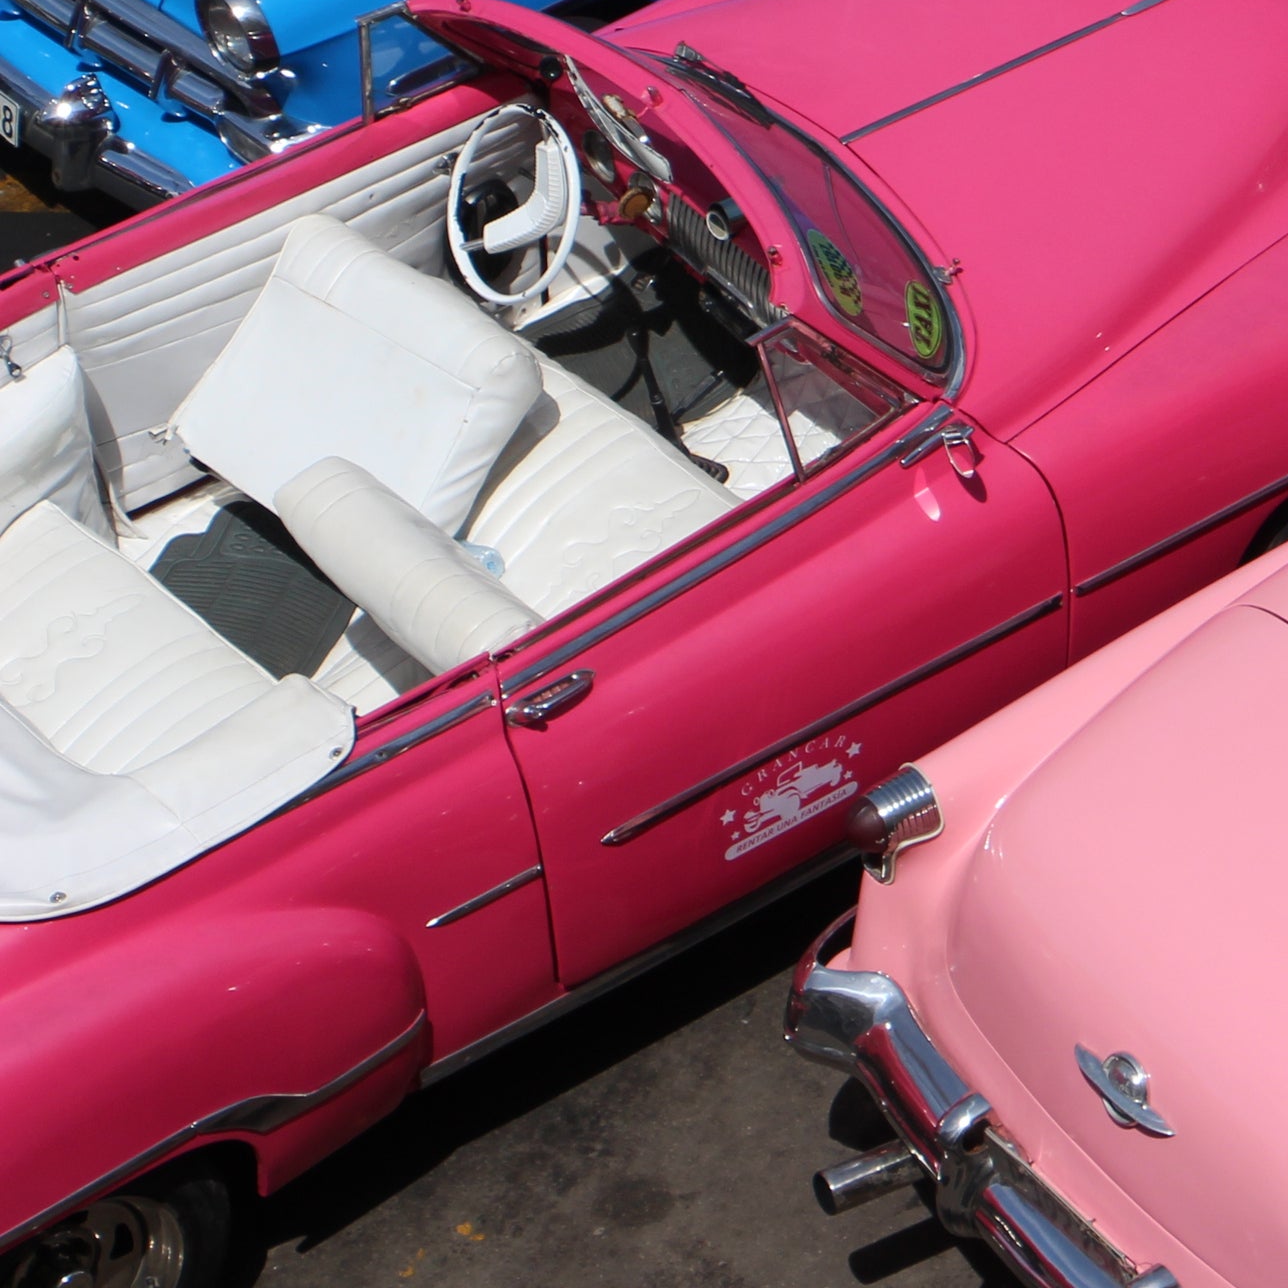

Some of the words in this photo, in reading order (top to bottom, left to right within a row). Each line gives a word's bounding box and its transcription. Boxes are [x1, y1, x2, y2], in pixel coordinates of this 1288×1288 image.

[2, 104, 14, 139] 8
[911, 284, 932, 349] TAXI
[741, 735, 847, 796] GRANCAR
[736, 828, 776, 854] RENTAR
[776, 814, 798, 831] UNA
